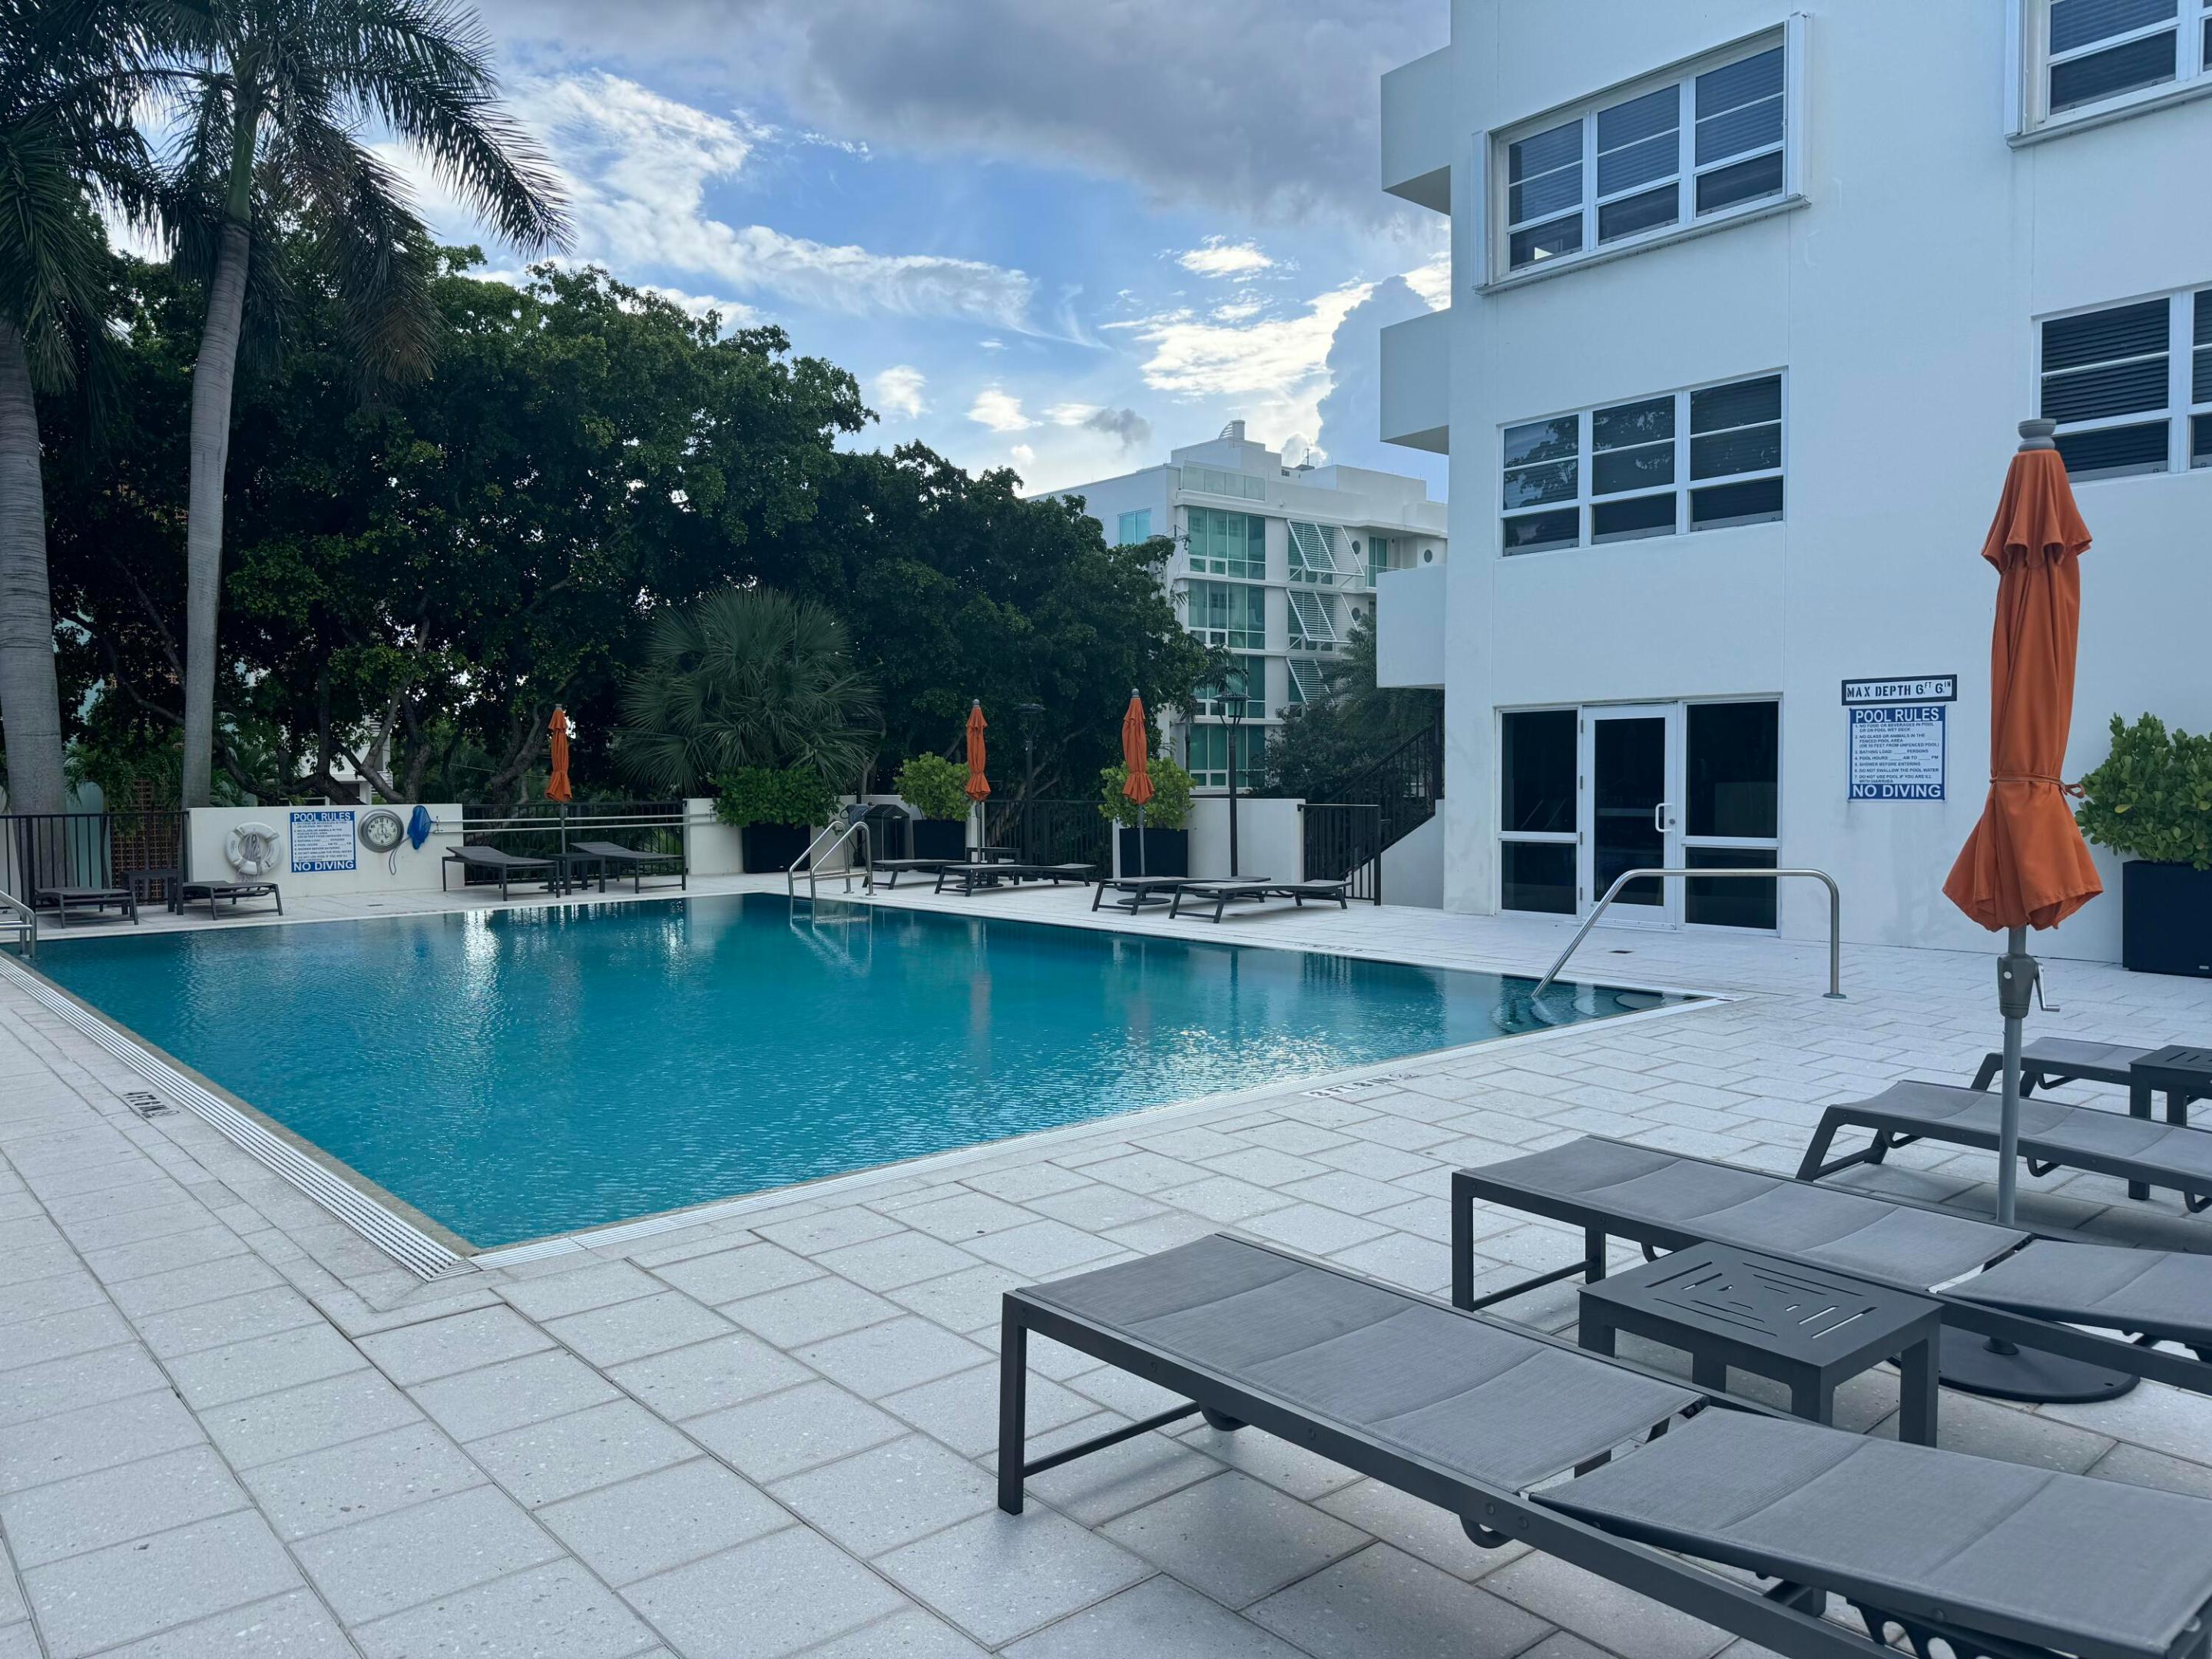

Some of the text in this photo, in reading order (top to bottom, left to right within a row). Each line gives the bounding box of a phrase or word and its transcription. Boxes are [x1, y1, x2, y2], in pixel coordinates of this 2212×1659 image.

[1847, 686, 1870, 698] MAX
[1875, 685, 1911, 696] DEPTH
[1856, 708, 1939, 723] POOL RULES
[1853, 785, 1941, 797] NO DIVING
[294, 812, 350, 822] POOL RULES
[294, 861, 354, 871] NO DIVING
